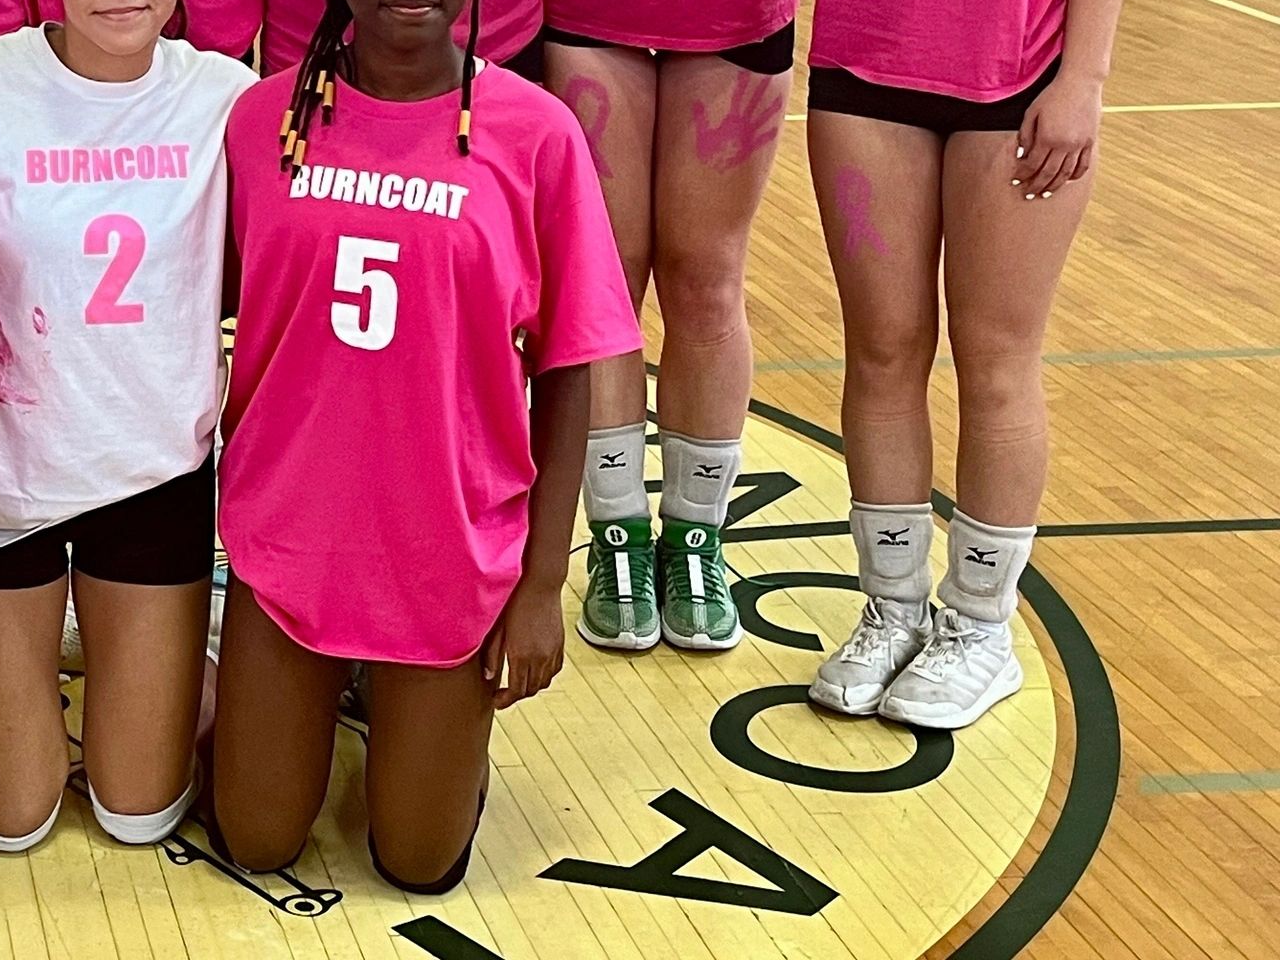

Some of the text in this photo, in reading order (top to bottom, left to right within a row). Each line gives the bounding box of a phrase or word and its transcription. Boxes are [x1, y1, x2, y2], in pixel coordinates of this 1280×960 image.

[26, 144, 191, 184] BURNCOAT
[289, 164, 469, 220] BURNCOAT
[82, 213, 147, 326] 2
[330, 234, 400, 351] 5
